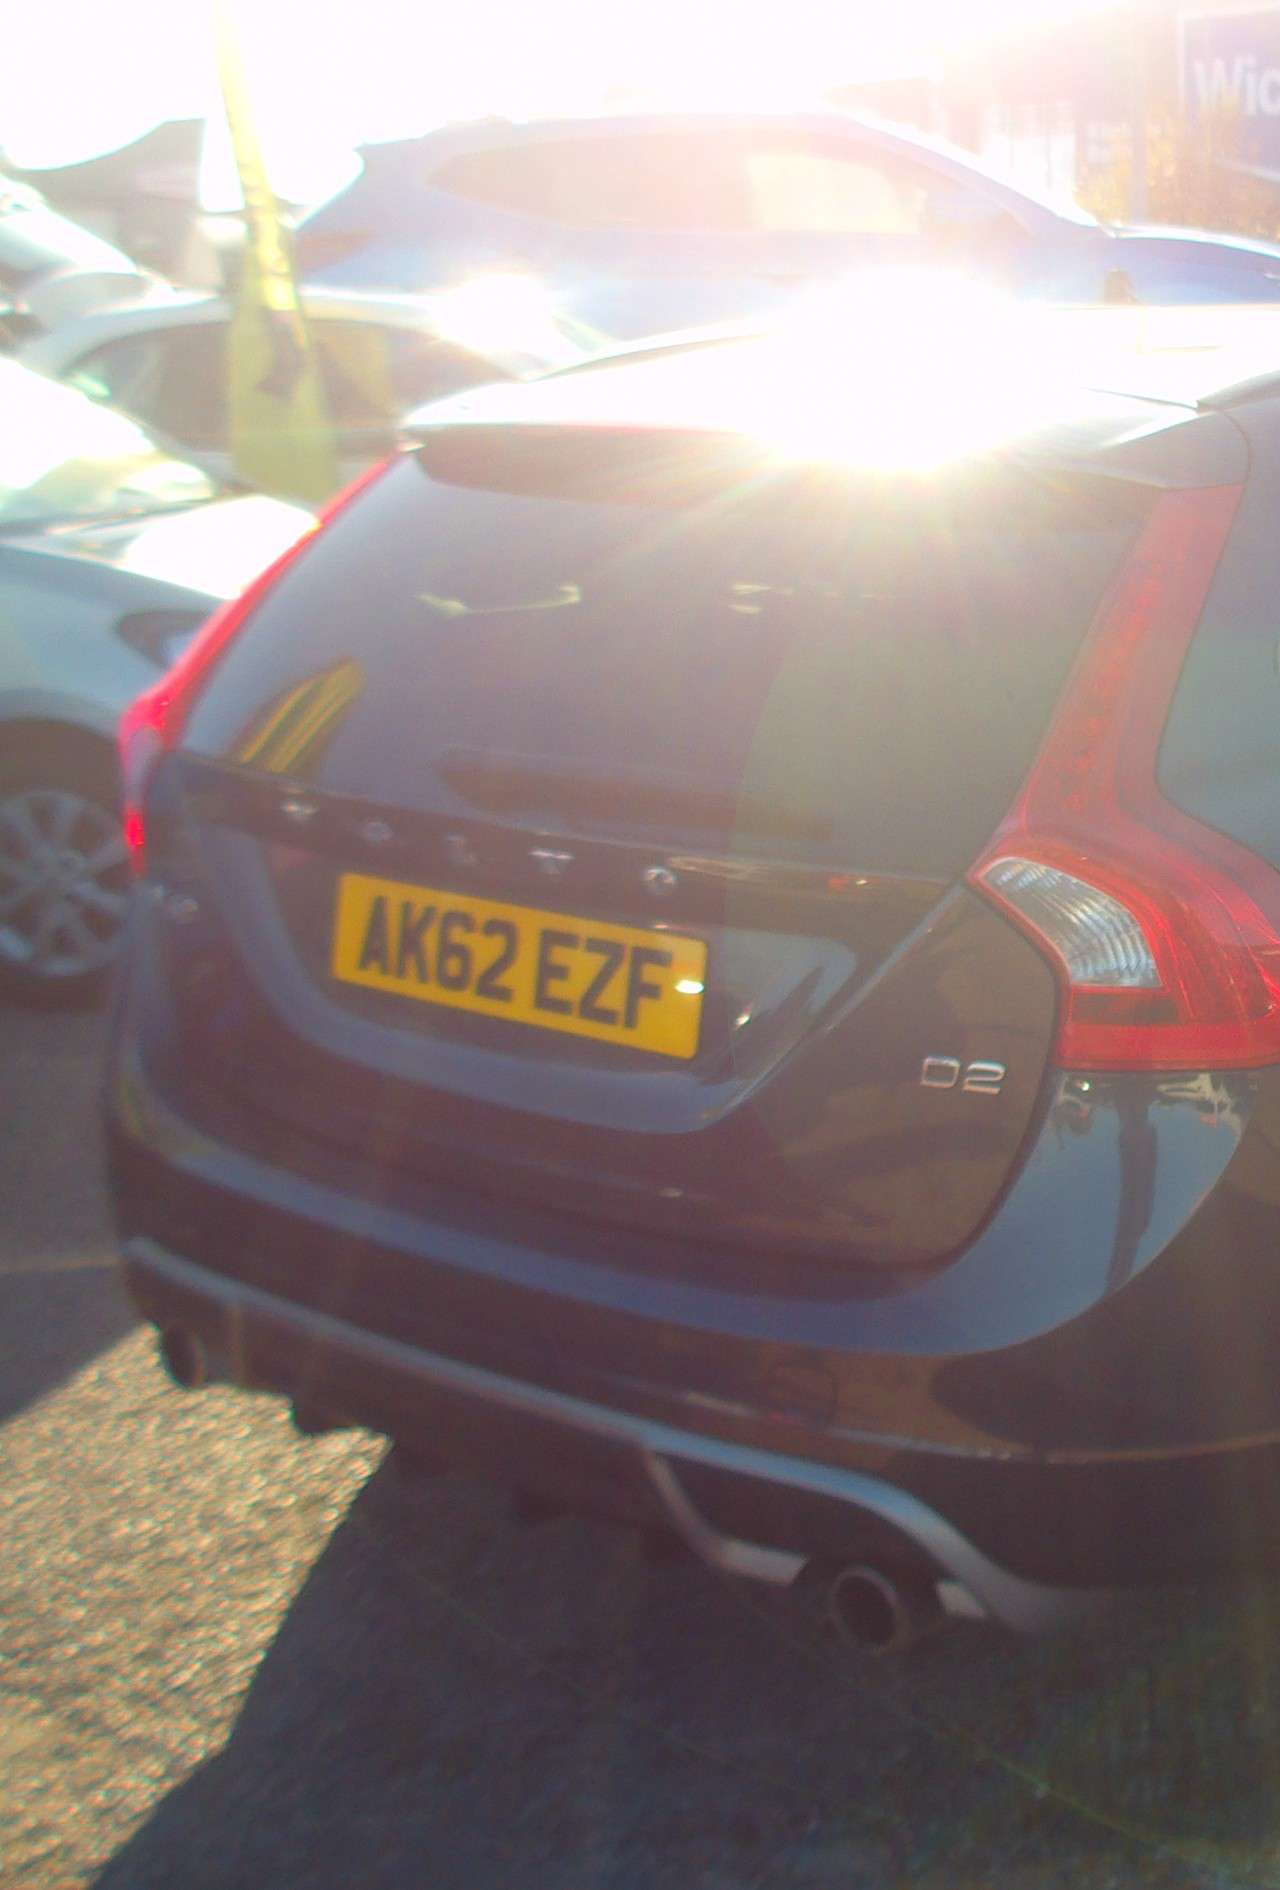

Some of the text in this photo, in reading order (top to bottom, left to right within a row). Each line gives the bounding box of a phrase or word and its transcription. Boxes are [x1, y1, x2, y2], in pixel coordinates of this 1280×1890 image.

[357, 895, 673, 1030] AK62 EZF
[920, 1056, 1007, 1096] D2
